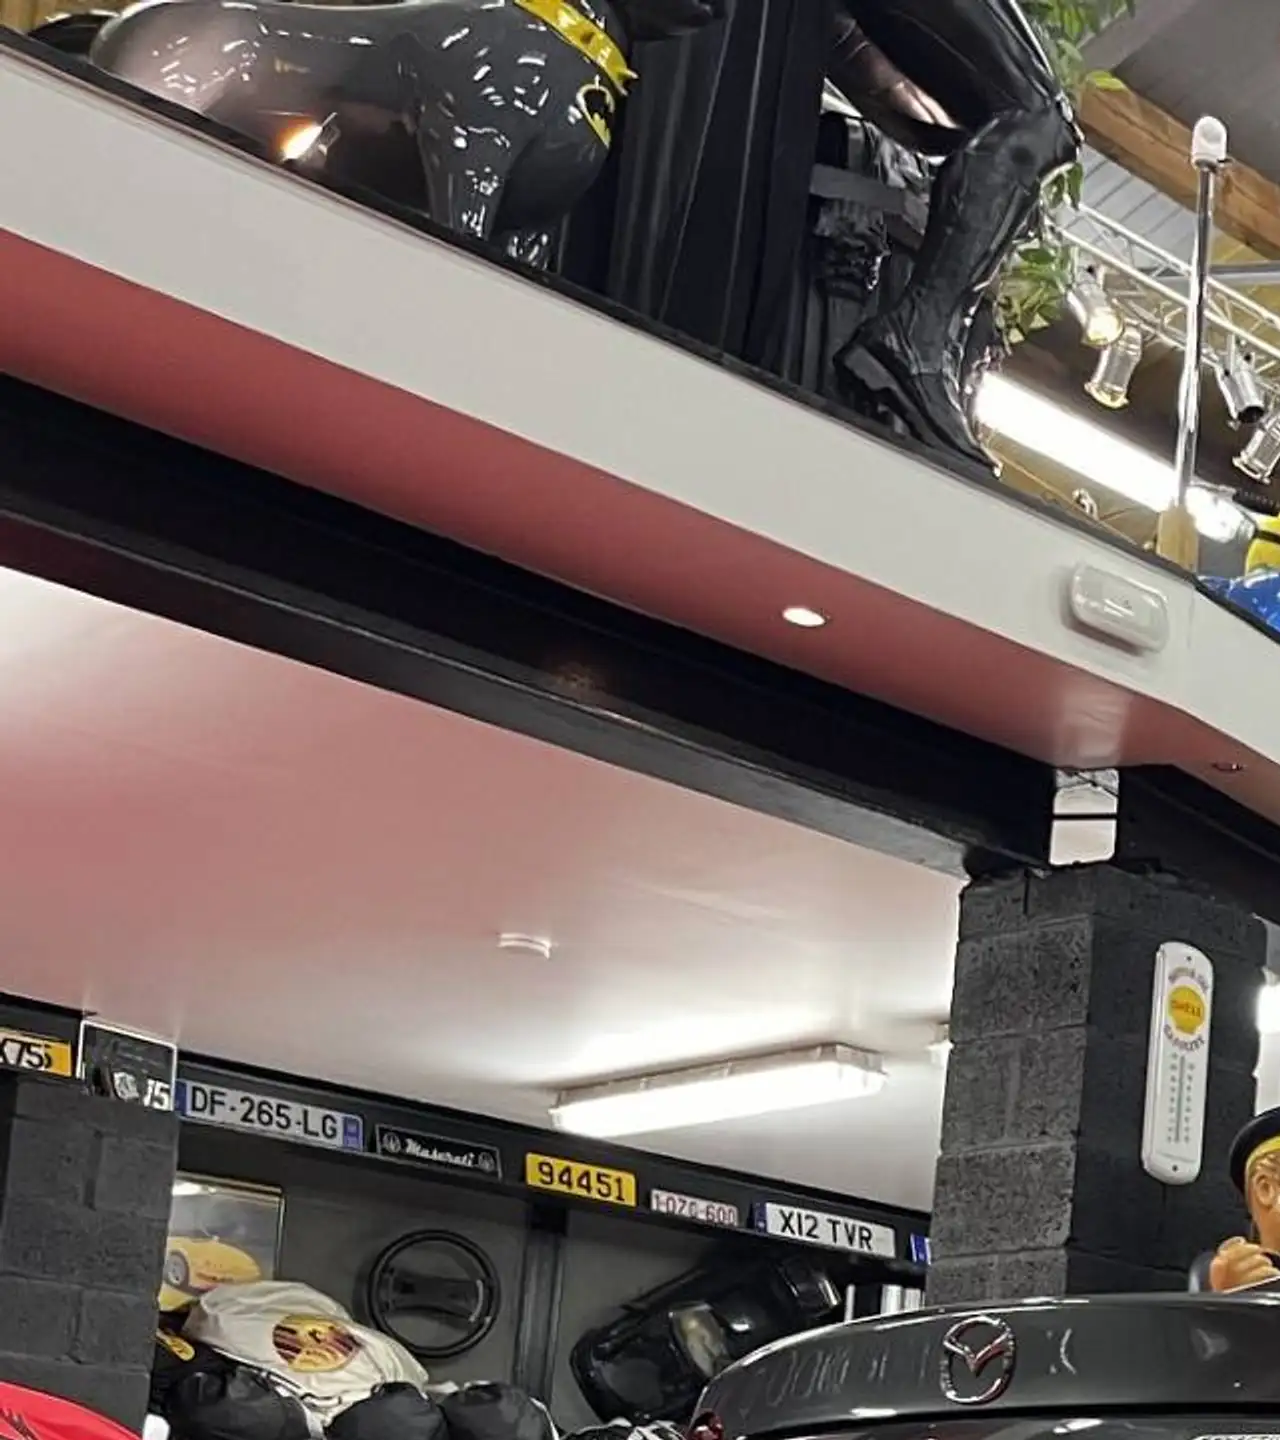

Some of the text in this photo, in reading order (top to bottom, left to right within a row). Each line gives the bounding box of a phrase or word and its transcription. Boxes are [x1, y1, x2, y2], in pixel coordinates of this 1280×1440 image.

[190, 1085, 338, 1140] DF-265-LG
[537, 1161, 626, 1202] 94451
[826, 1218, 873, 1251] TVR
